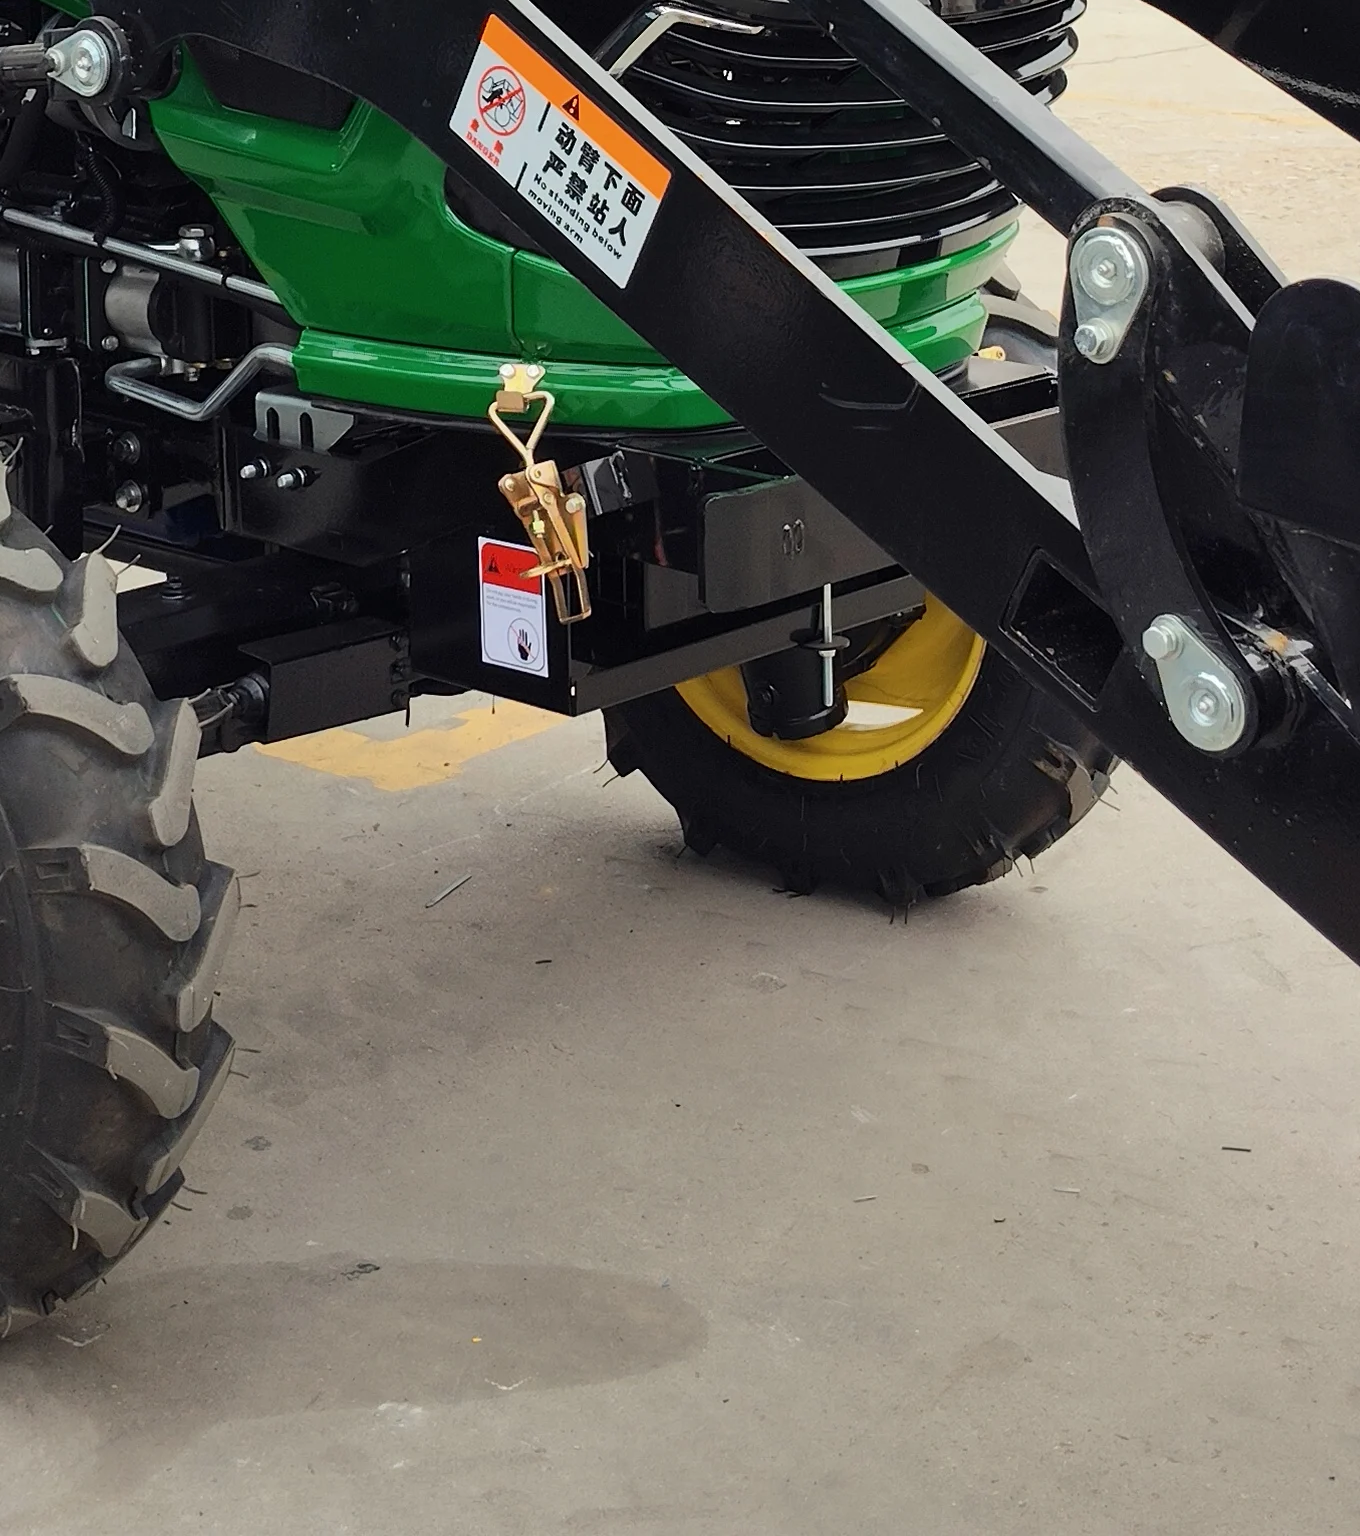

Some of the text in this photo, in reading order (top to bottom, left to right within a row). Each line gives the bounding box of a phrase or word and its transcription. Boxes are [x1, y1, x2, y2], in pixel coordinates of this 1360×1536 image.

[465, 130, 501, 167] DANGER
[554, 121, 646, 217] 动臂下面
[528, 189, 584, 245] moving arm
[542, 150, 628, 247] 严禁站人
[548, 189, 591, 233] standing
[591, 227, 623, 260] below
